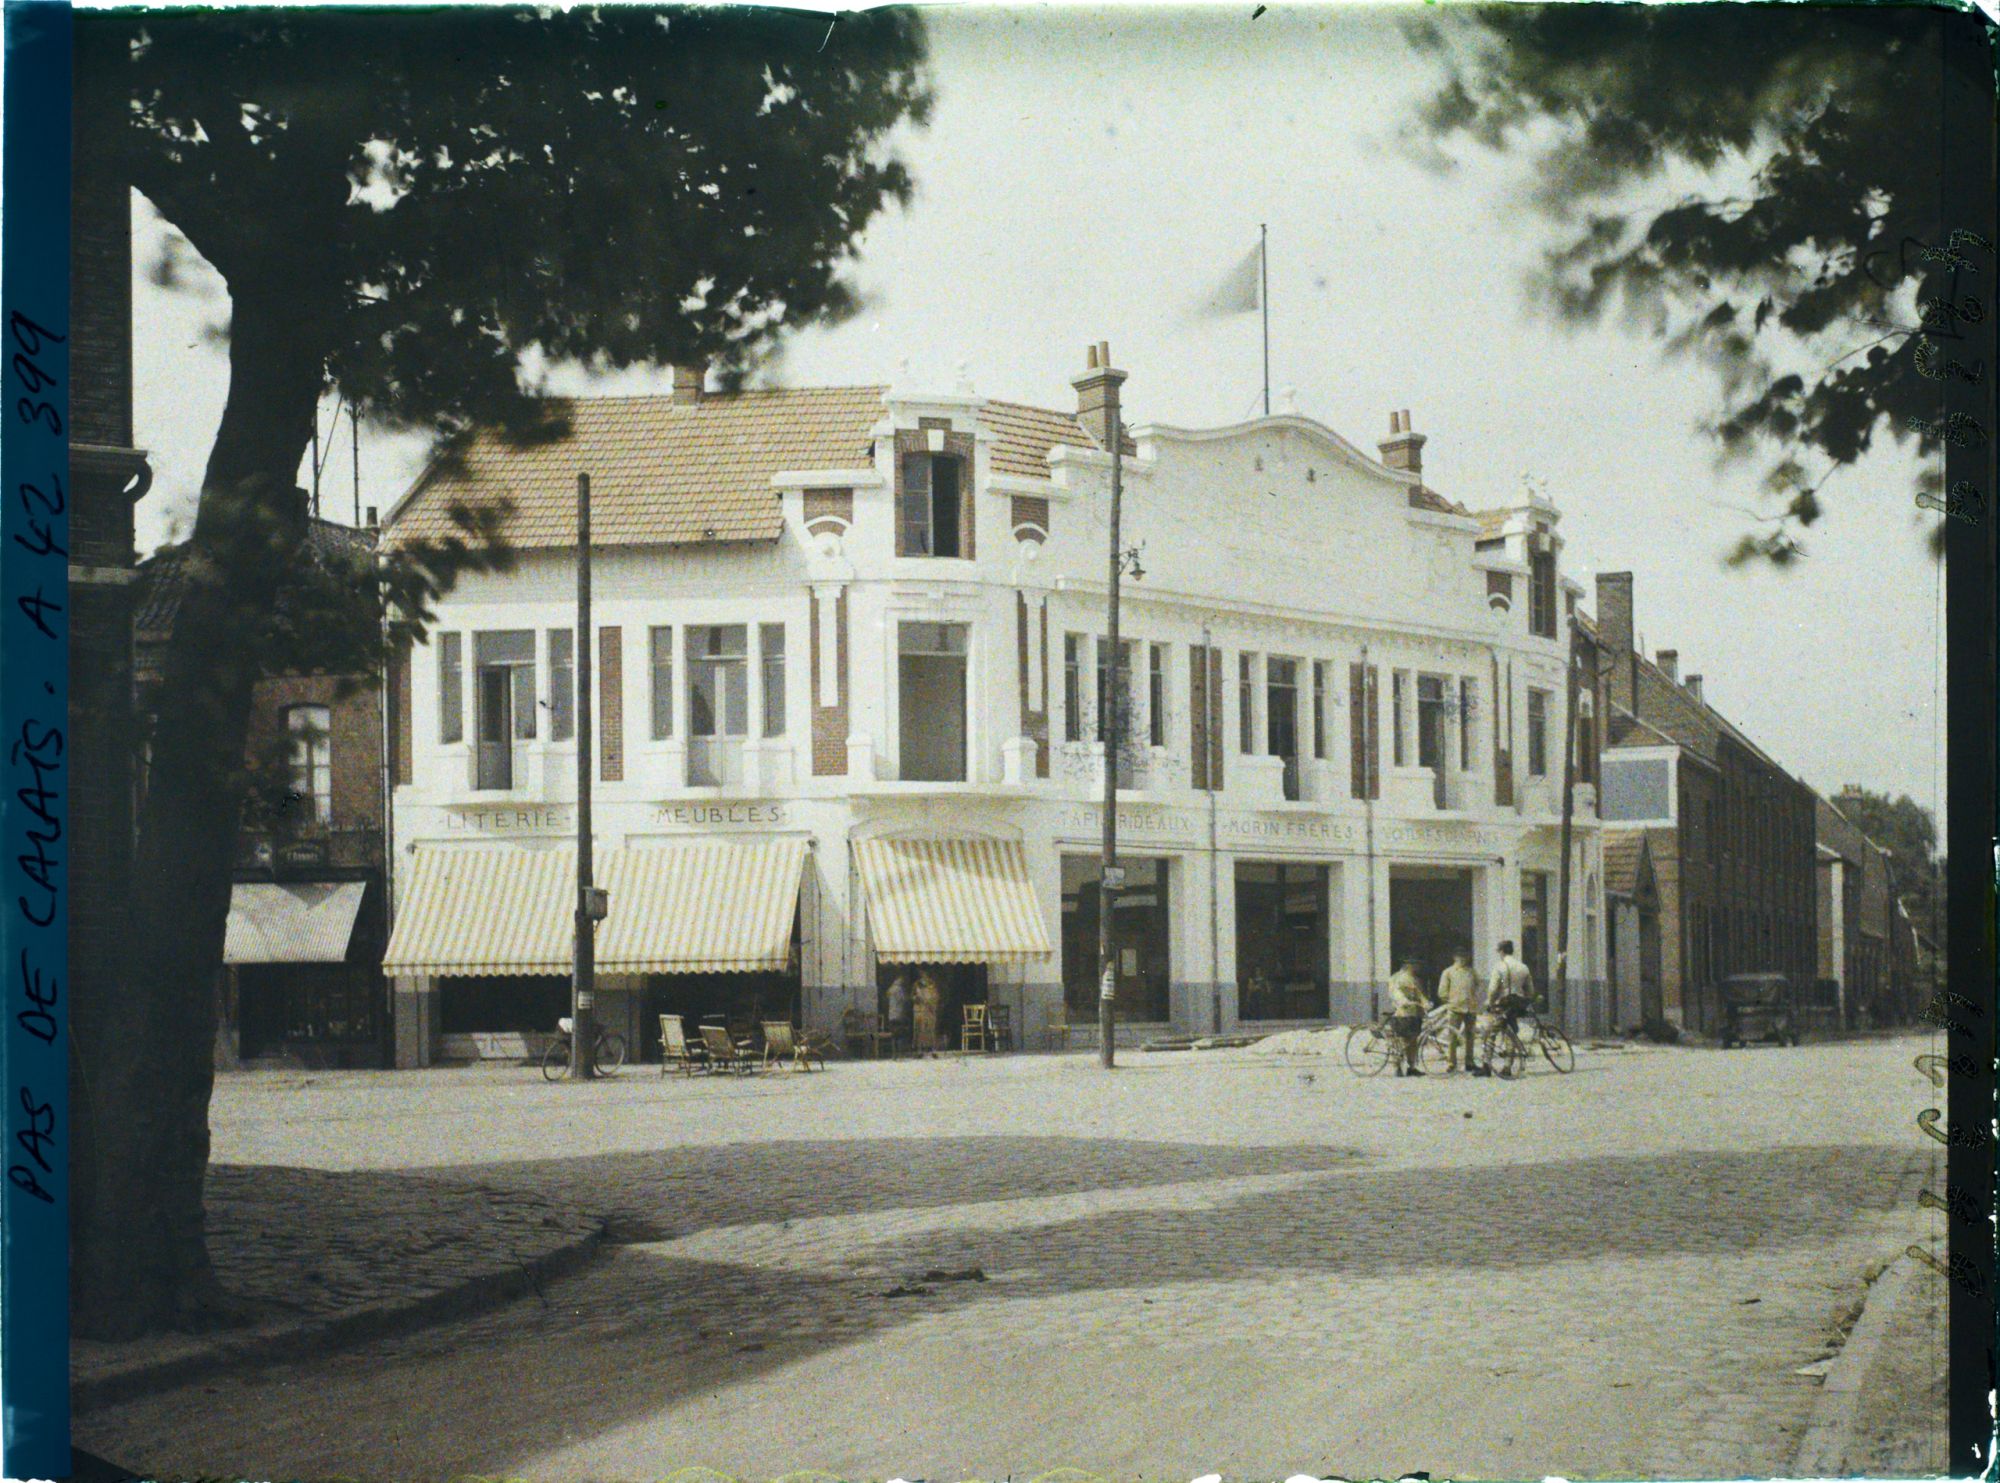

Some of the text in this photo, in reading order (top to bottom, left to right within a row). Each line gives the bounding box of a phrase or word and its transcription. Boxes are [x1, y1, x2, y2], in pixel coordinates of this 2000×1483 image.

[446, 810, 560, 831] LITERIE
[656, 805, 781, 825] MEUBLES
[1229, 818, 1280, 836] MORIN
